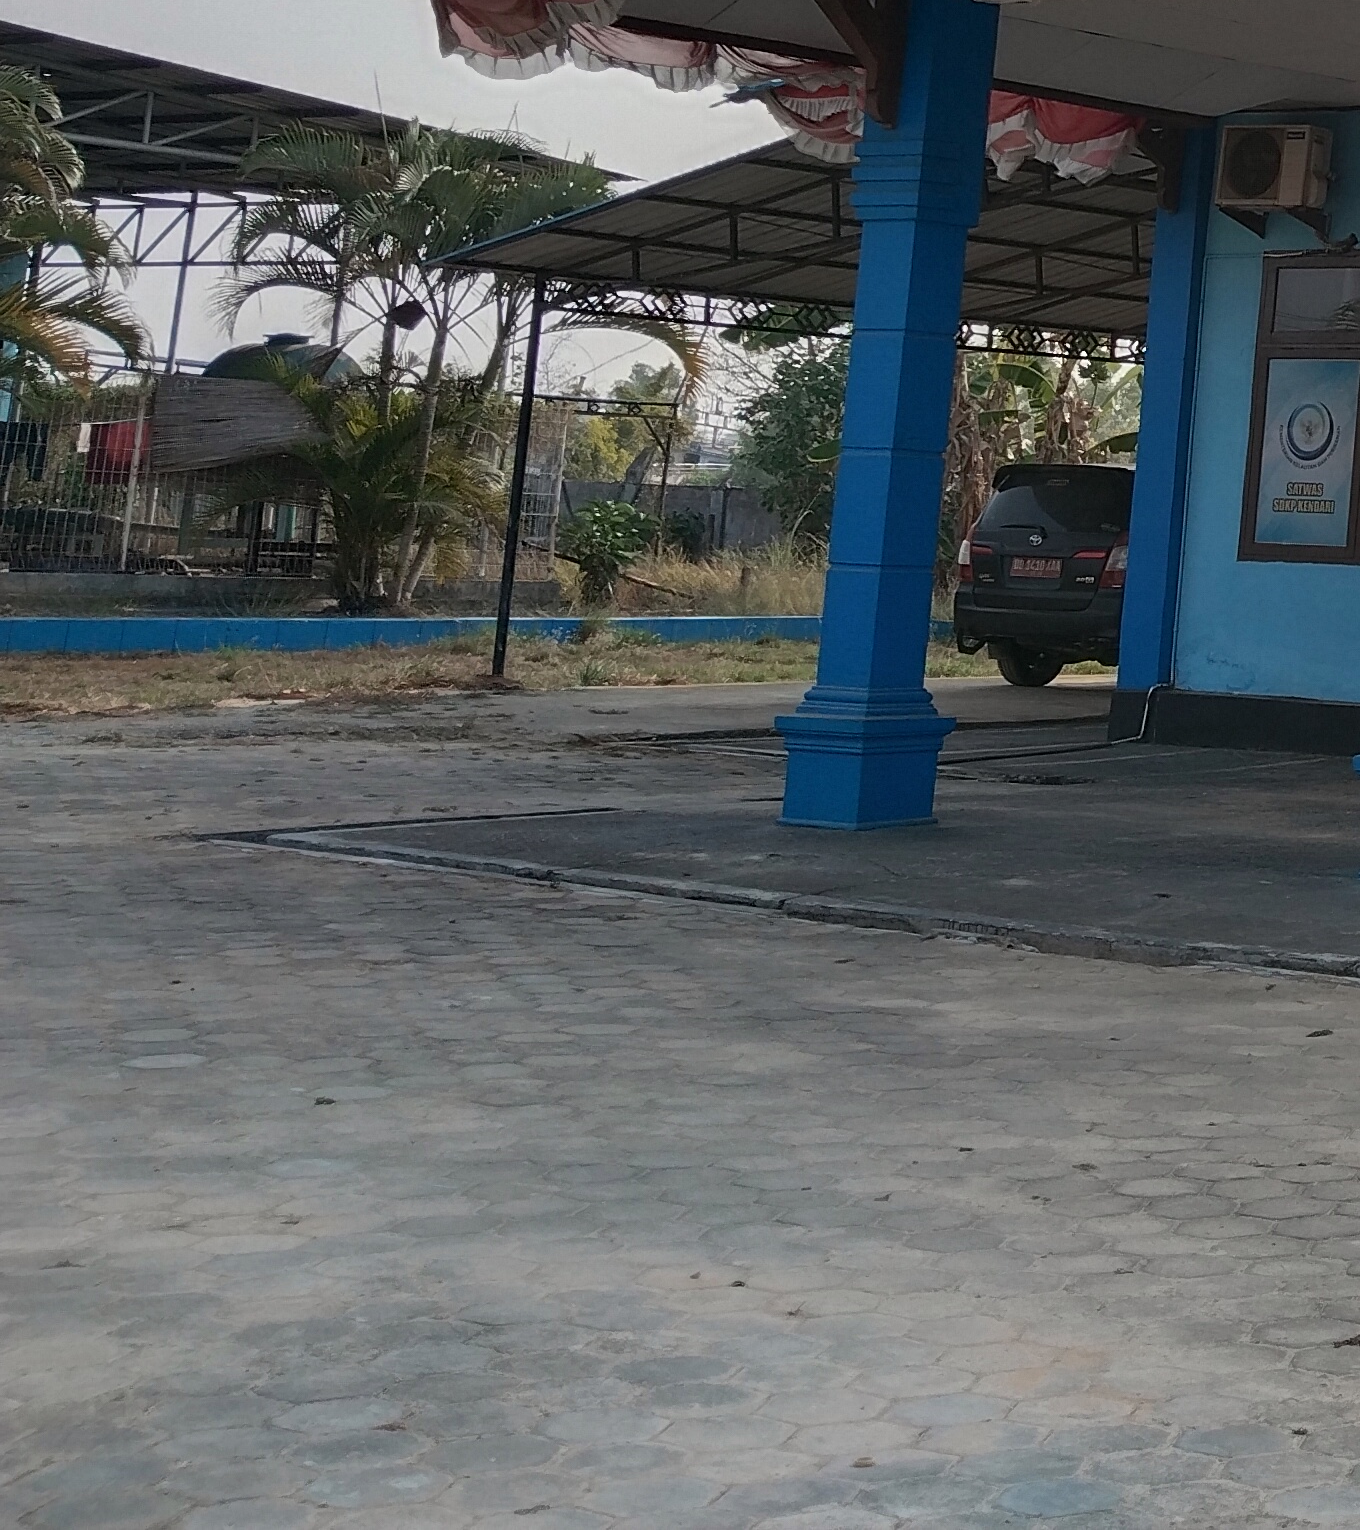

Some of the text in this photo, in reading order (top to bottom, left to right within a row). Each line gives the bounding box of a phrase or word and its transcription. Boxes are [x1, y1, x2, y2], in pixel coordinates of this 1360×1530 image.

[1287, 481, 1324, 497] SATWAS
[1272, 498, 1335, 514] SDKP KENDARI
